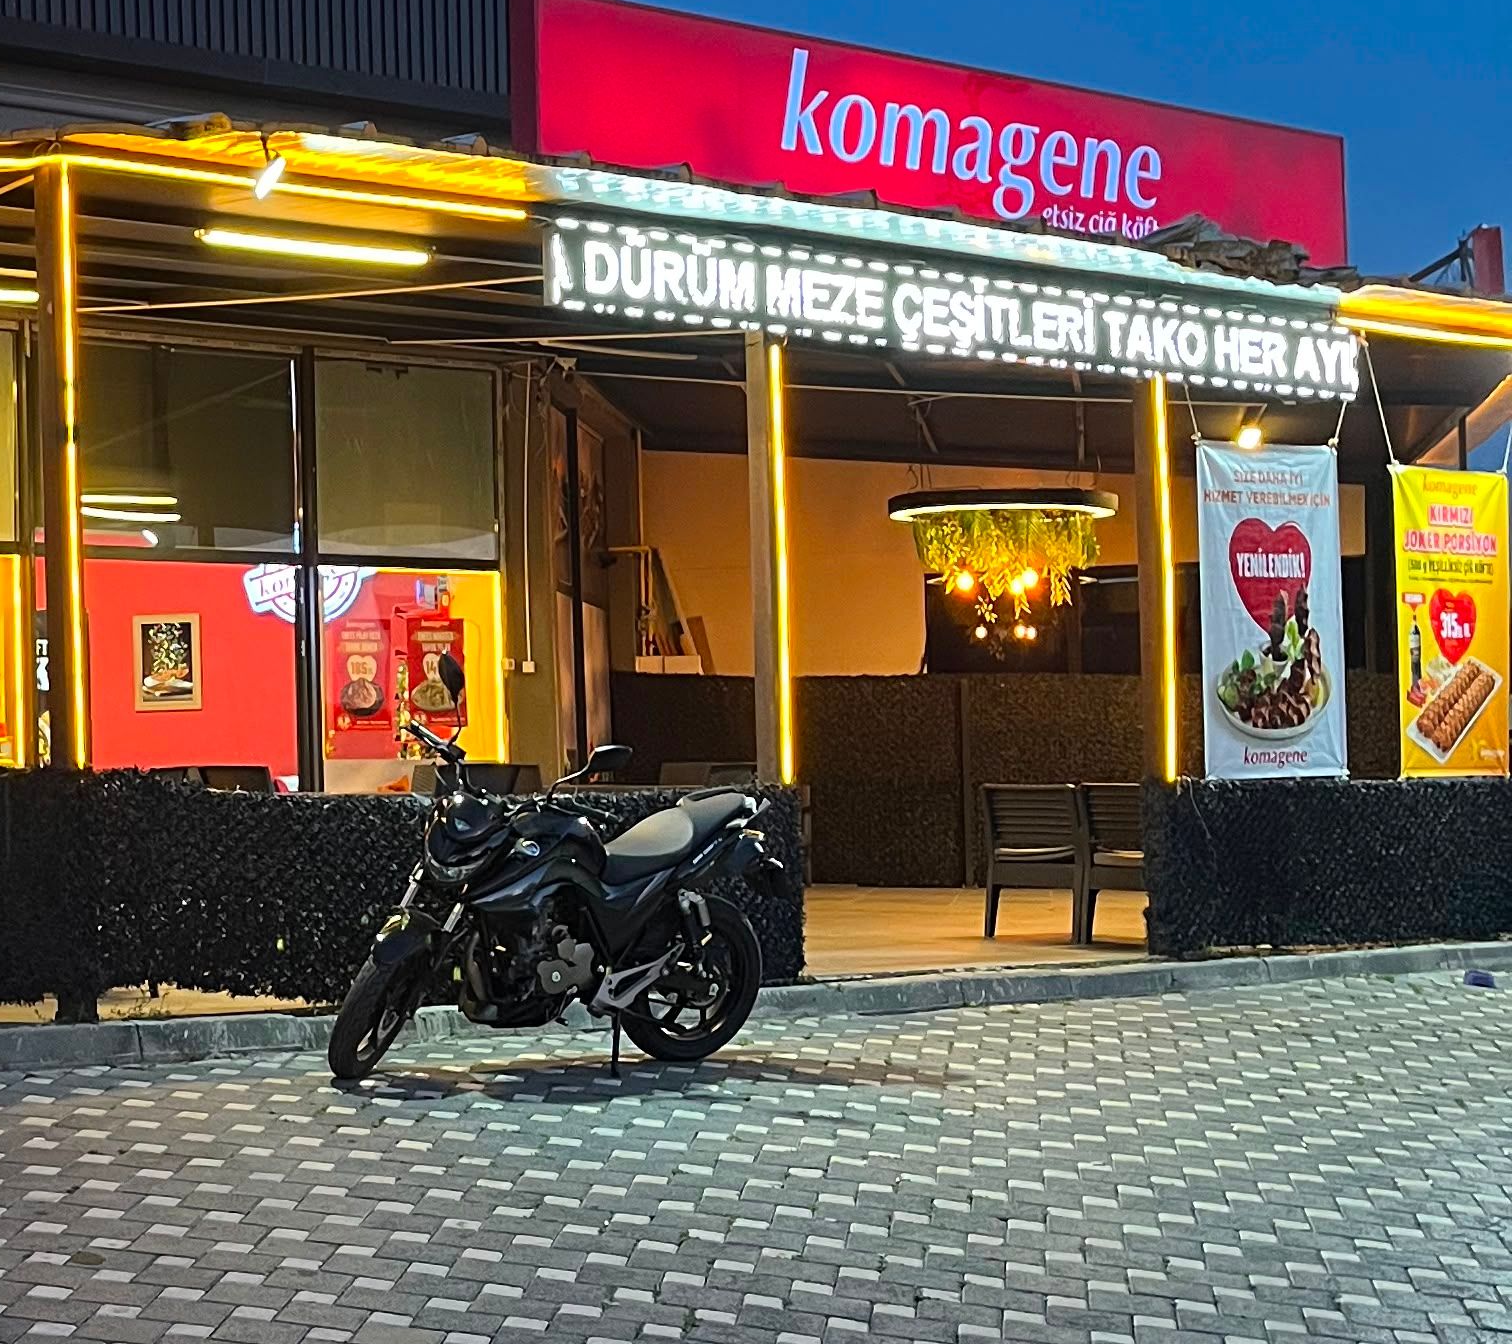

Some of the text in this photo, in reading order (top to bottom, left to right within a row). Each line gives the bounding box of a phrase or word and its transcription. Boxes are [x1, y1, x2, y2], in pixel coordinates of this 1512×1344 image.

[781, 47, 1161, 220] komagene
[1042, 203, 1085, 233] etsiz
[584, 232, 756, 313] DÜRÜM
[765, 263, 886, 330] MEZE
[891, 276, 1096, 355] ÇEŞİTLERİ
[1102, 310, 1209, 368] TAKO
[1214, 324, 1288, 378] HER
[1430, 505, 1473, 524] KIRMIZI
[1404, 530, 1440, 549] JOKER
[1236, 547, 1306, 578] YENİLENDİK!
[1243, 746, 1308, 769] komagene
